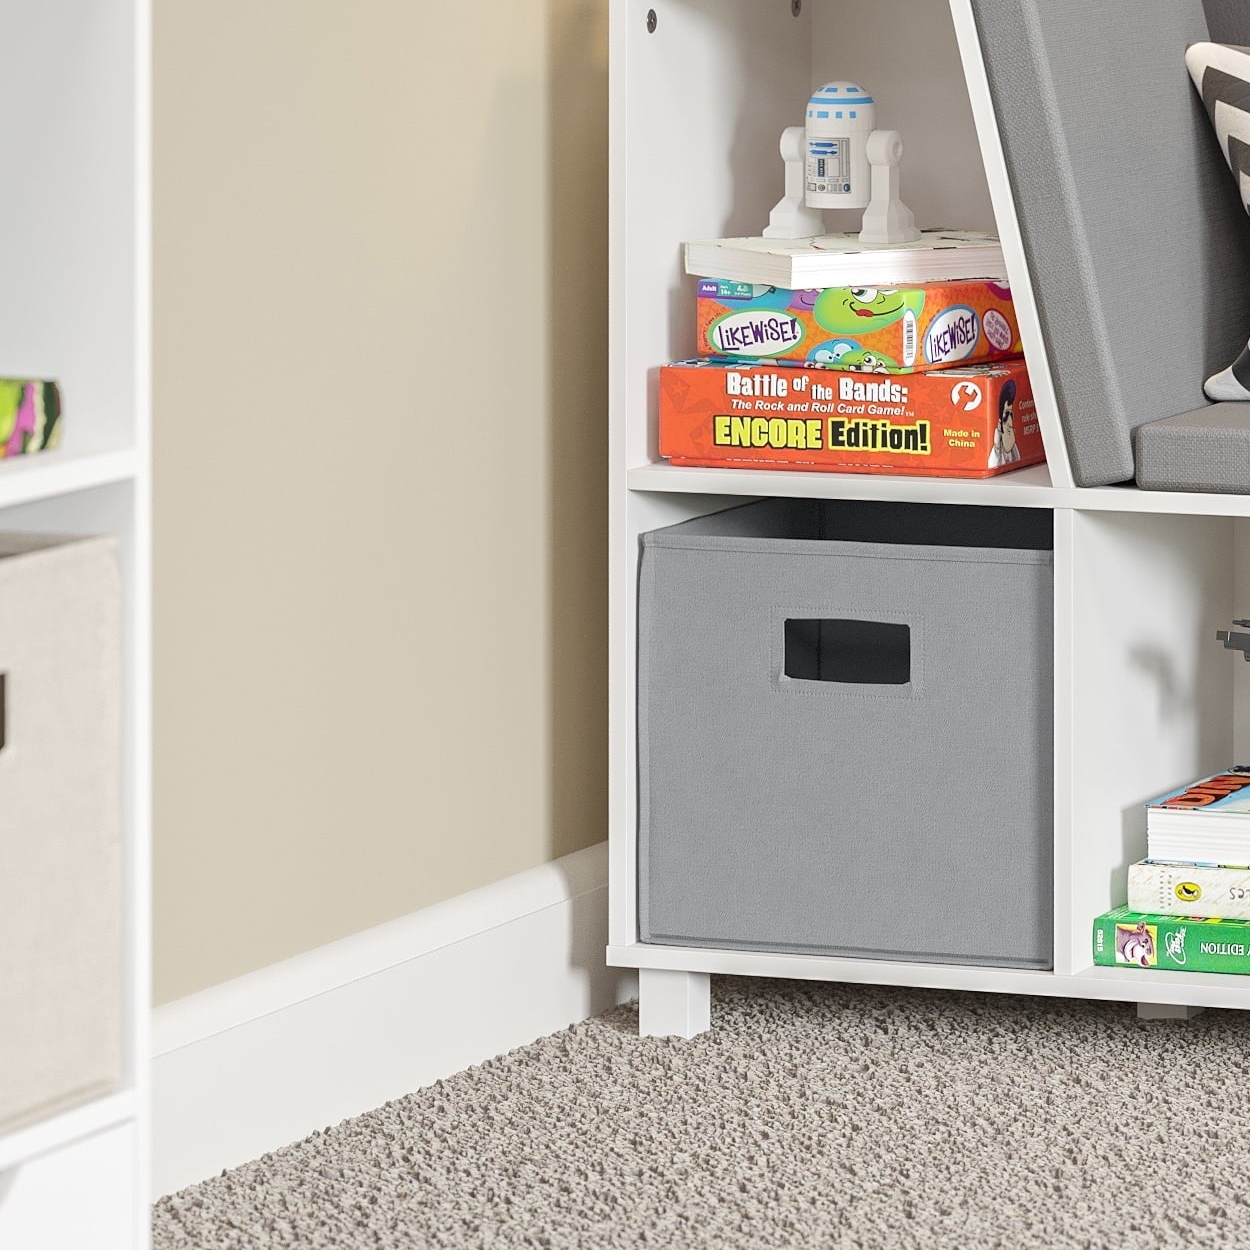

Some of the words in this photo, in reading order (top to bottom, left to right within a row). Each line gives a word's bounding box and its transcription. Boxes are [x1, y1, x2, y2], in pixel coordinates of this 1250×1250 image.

[726, 372, 788, 397] Battle
[793, 375, 810, 392] of
[811, 384, 833, 400] the
[839, 377, 908, 403] Bands:
[731, 399, 752, 411] The
[754, 400, 784, 412] Rock
[786, 401, 808, 413] and
[811, 403, 834, 414] Roll
[837, 403, 865, 415] Card
[867, 405, 905, 417] Game!
[714, 415, 823, 449] ENCORE
[829, 418, 930, 454] Edition!
[943, 429, 969, 438] Made
[971, 429, 981, 438] in
[948, 439, 976, 448] China
[1200, 942, 1244, 955] EDITION
